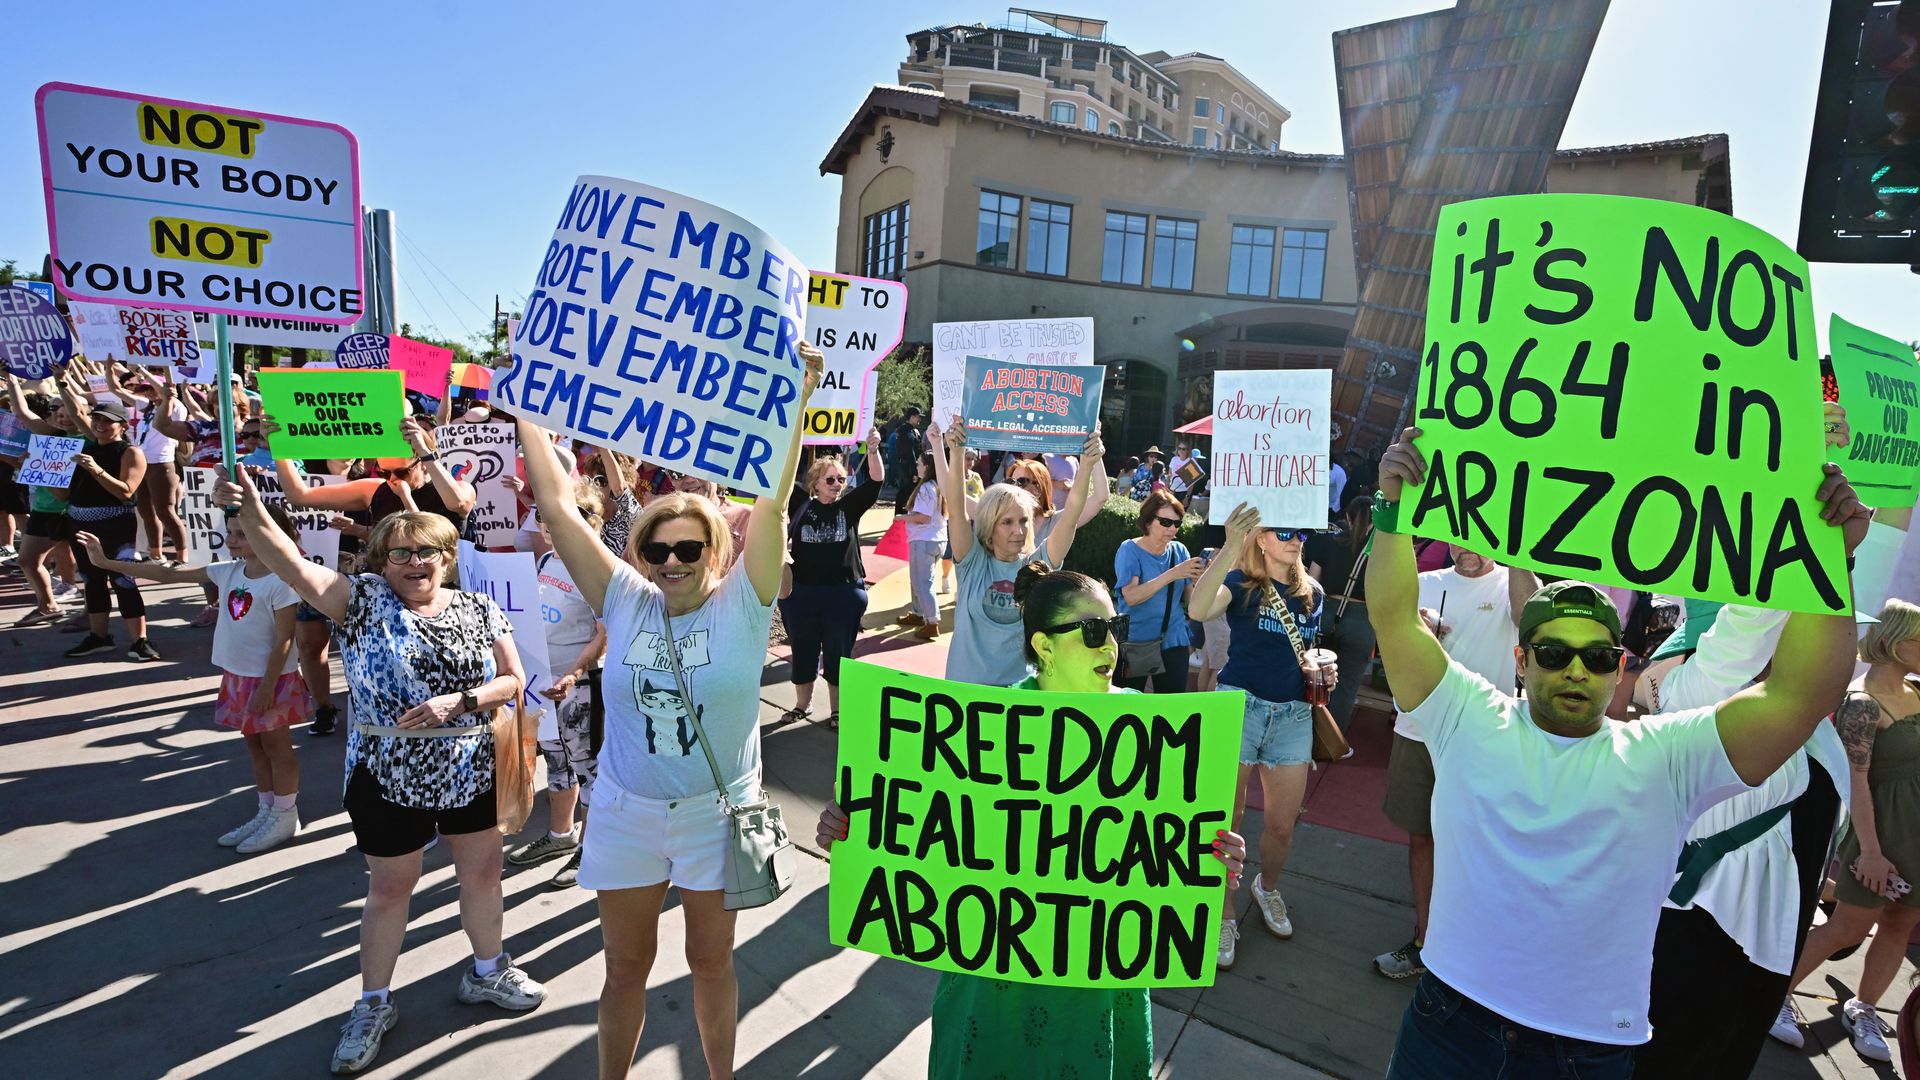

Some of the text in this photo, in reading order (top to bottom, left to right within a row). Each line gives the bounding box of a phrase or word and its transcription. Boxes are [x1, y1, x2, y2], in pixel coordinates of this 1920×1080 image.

[143, 105, 260, 155] NOT
[66, 142, 338, 205] YOUR BODY
[154, 219, 268, 265] NOT
[556, 183, 805, 319] NOVEMBER
[54, 258, 362, 315] YOUR CHOICE
[861, 287, 889, 309] TO
[1450, 218, 1804, 361] it's NOT
[0, 289, 41, 315] EEP
[537, 239, 800, 369] ROEVEMBER
[119, 310, 187, 328] BODIES
[140, 328, 176, 339] OUR
[344, 334, 386, 352] KEEP
[816, 327, 877, 351] IS AN
[998, 322, 1022, 347] BE
[1026, 322, 1085, 347] TRUSTED
[6, 342, 65, 369] EGAL
[125, 335, 200, 360] RIGHTS
[514, 290, 797, 429] JOEVEMBER
[981, 368, 1084, 397] ABORTION
[1865, 370, 1919, 409] PROTECT
[293, 392, 367, 407] PROTECT
[991, 390, 1070, 416] ACCESS
[1217, 390, 1312, 431] abortion
[1418, 338, 1782, 472] 1864 in
[314, 407, 351, 421] OUR
[497, 354, 773, 489] REMEMBER
[968, 418, 1087, 434] SAFE, LEGAL, ACCESSIBLE
[1883, 404, 1908, 435] OUR
[287, 421, 384, 437] DAUGHTERS
[442, 424, 500, 437] need to
[463, 432, 515, 446] about
[35, 436, 54, 449] WE
[54, 438, 79, 450] ARE
[42, 450, 68, 460] NOT
[20, 468, 72, 486] REACTING
[186, 471, 205, 490] IF
[1213, 452, 1327, 488] HEALTHCARE
[188, 513, 213, 529] IN
[1411, 448, 1846, 611] ARIZONA
[191, 531, 225, 550] I'D
[1563, 608, 1593, 616] ESSENTIALS
[879, 686, 1202, 803] FREEDOM
[840, 765, 1227, 888] HEALTHCARE
[846, 866, 1209, 981] ABORTION
[1617, 1019, 1631, 1029] alo
